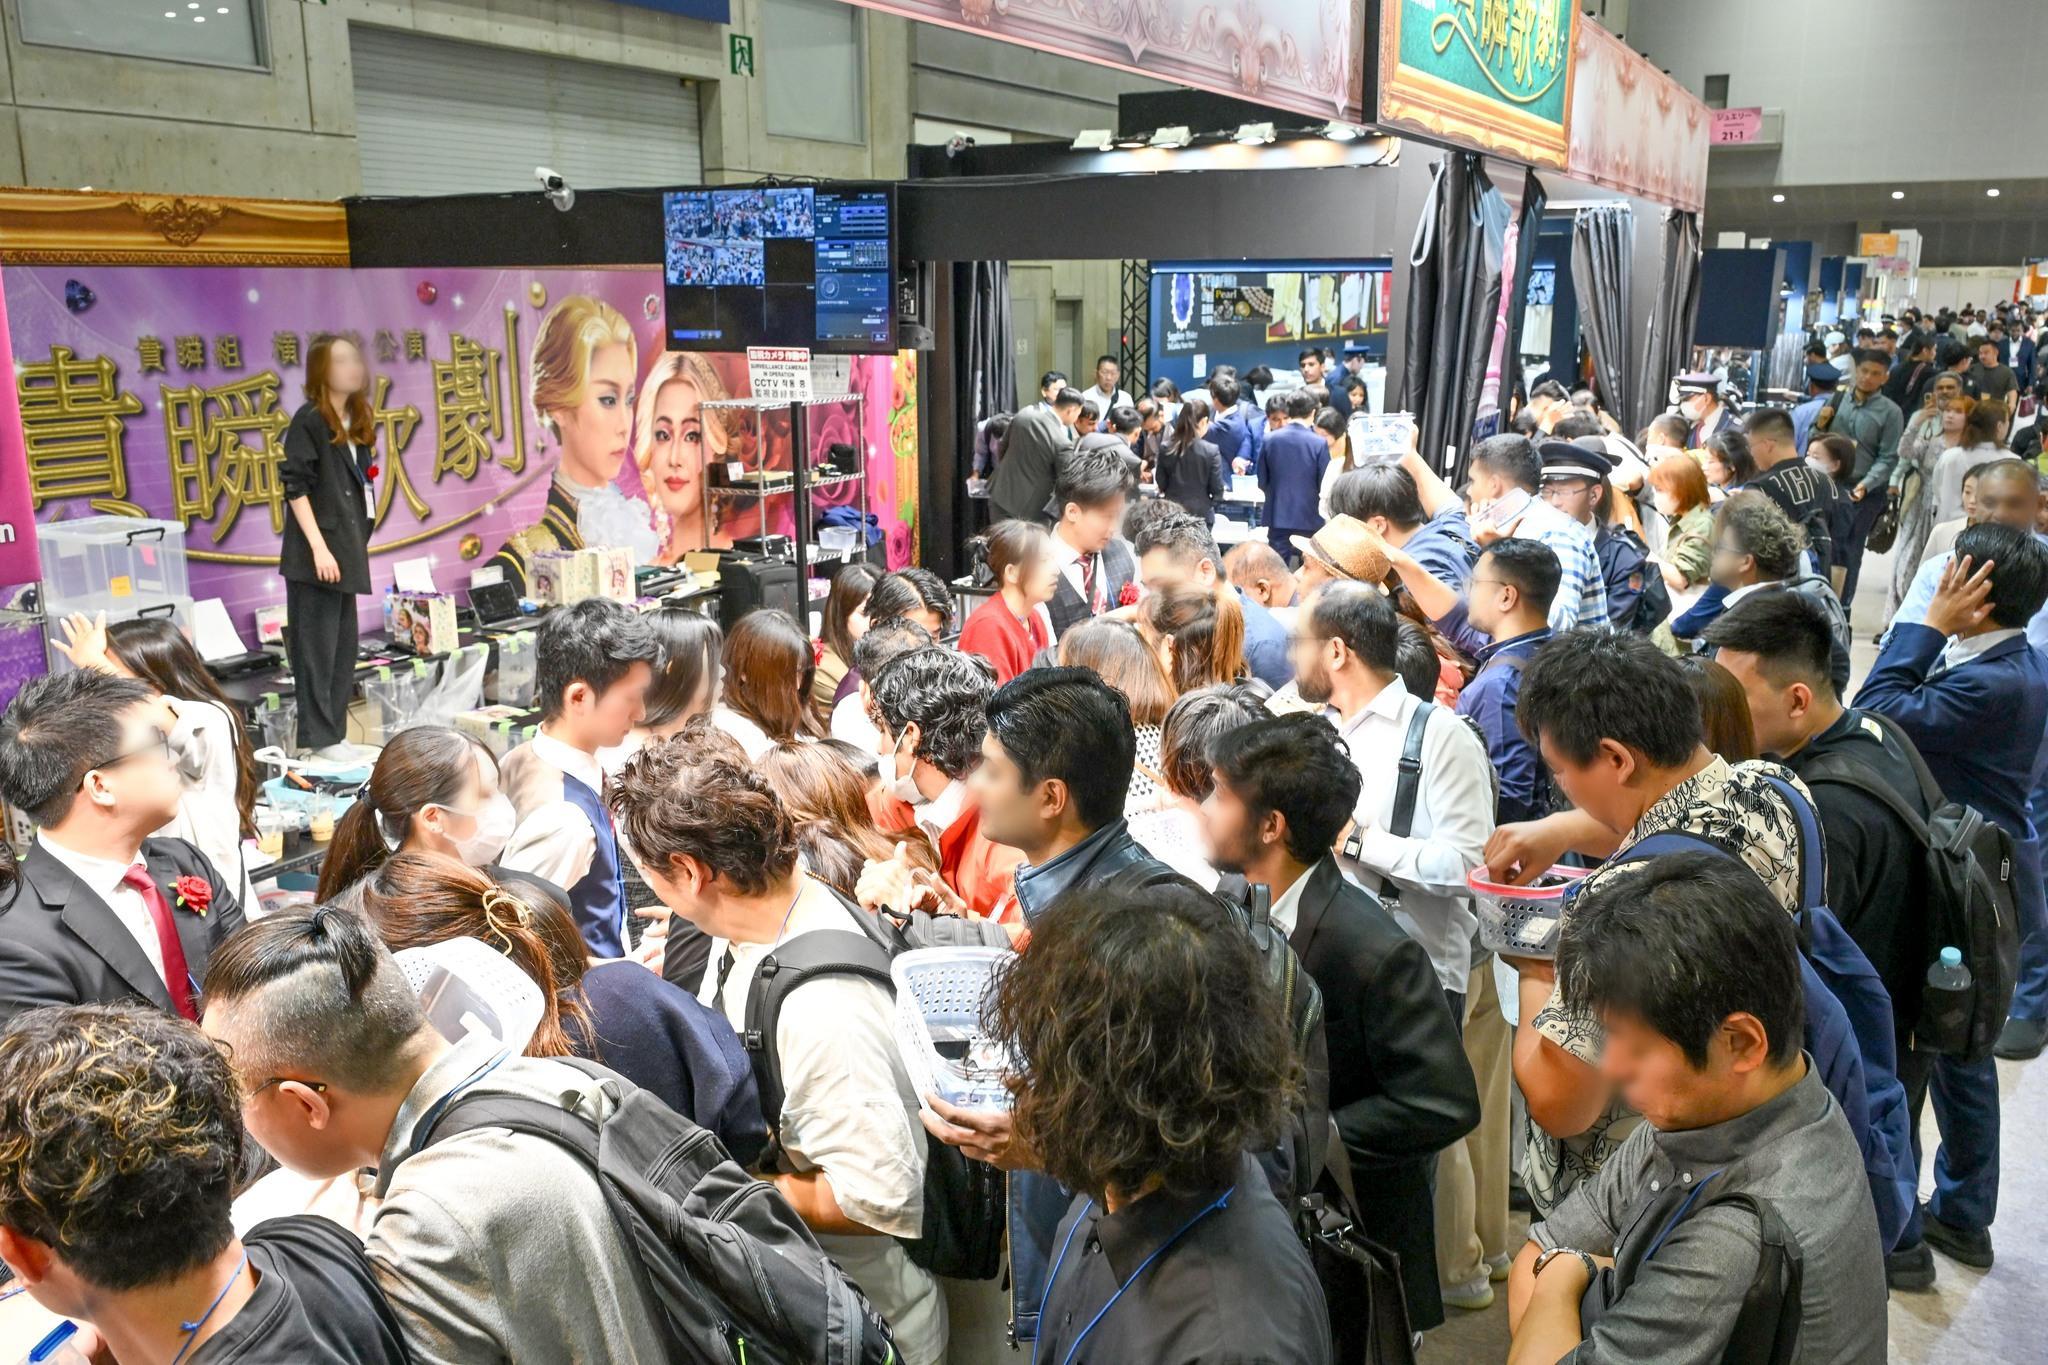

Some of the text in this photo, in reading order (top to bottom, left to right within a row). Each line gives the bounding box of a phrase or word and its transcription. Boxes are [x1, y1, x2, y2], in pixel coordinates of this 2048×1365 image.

[1716, 112, 1752, 121] ジュエリー
[1722, 131, 1743, 140] 21-1
[1215, 289, 1237, 299] Pearl
[137, 329, 427, 373] 貴瞬組 横公演
[754, 379, 778, 387] CCTV
